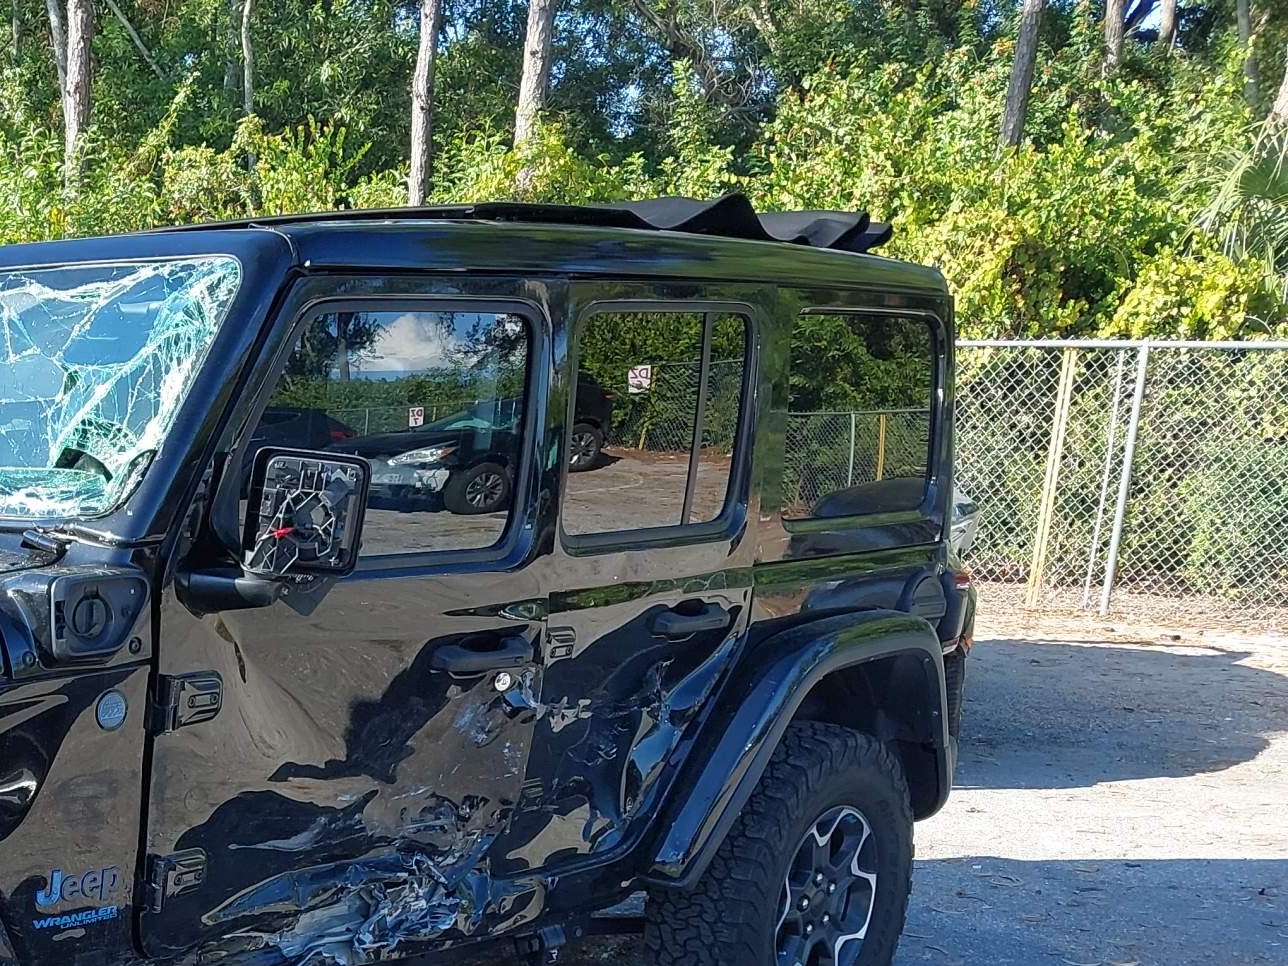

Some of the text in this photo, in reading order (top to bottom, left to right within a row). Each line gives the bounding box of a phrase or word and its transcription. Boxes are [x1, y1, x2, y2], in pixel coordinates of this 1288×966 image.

[35, 866, 120, 906] Jeep
[33, 905, 117, 929] WRANGLER
[61, 914, 117, 929] UNLIMITED
